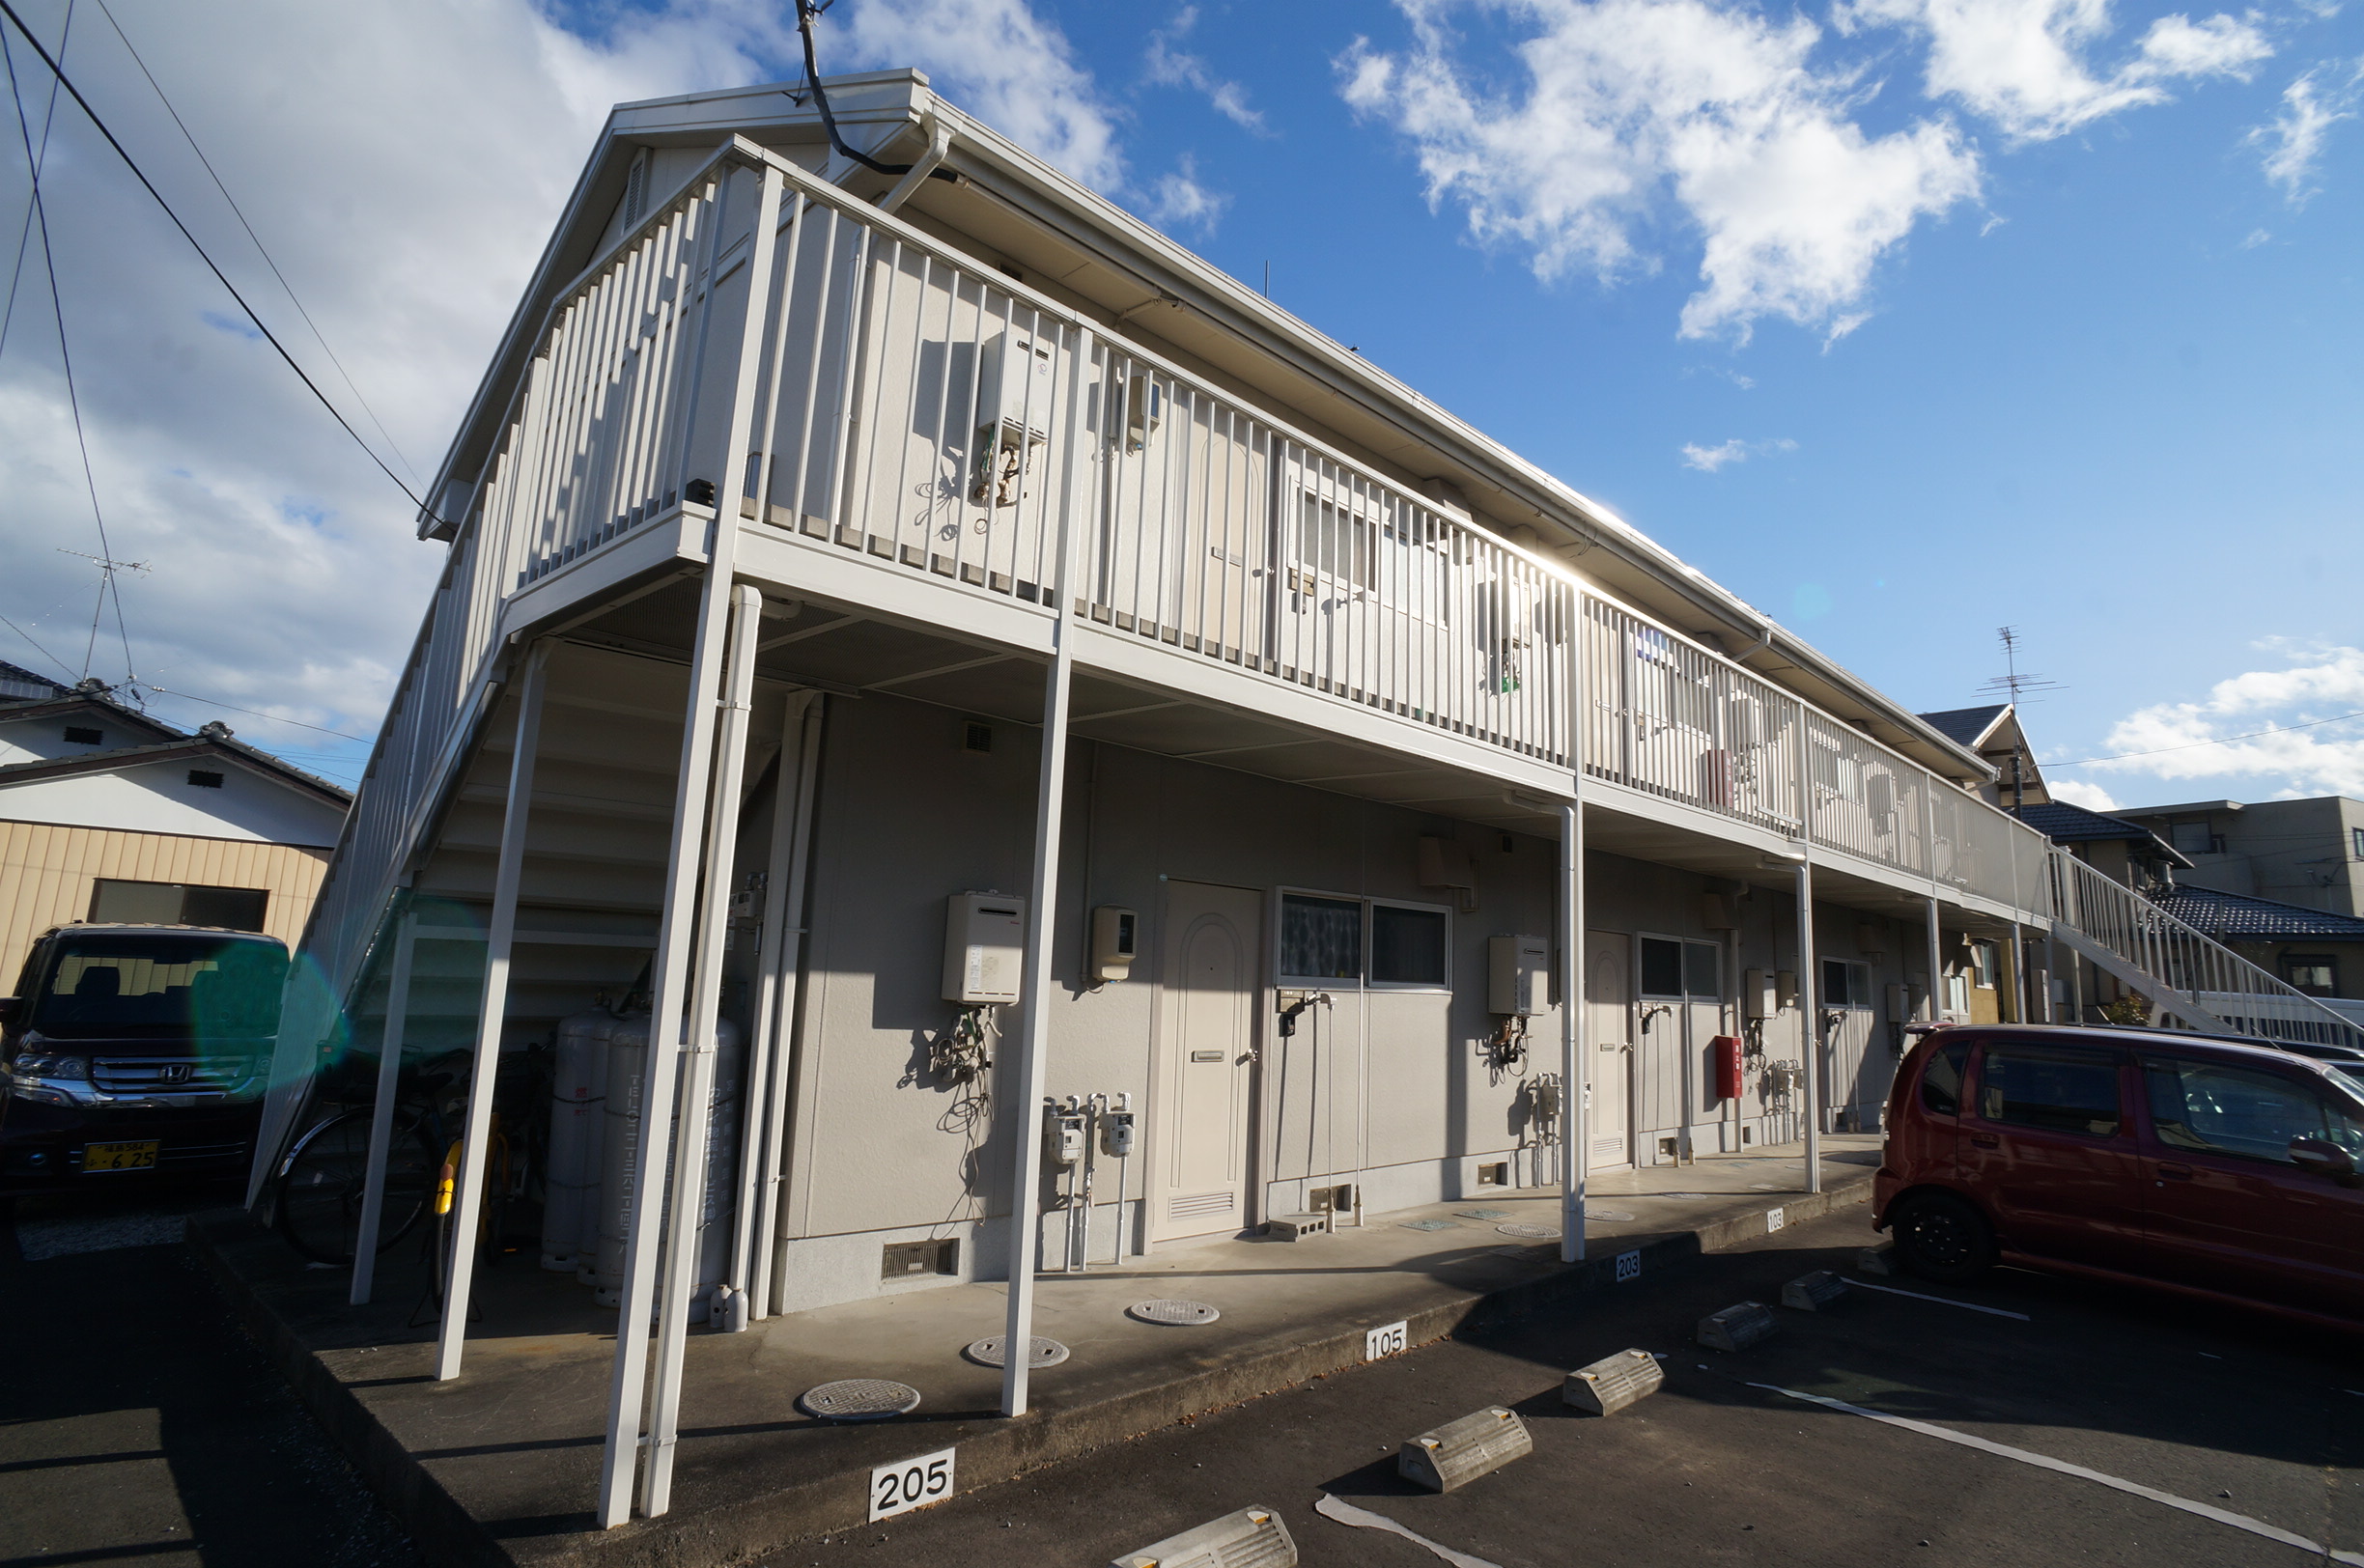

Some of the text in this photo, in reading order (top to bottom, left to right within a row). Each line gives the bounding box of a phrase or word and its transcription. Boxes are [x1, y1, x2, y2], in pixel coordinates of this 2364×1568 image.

[1769, 1212, 1782, 1230] 103
[1618, 1255, 1639, 1277] 203
[1371, 1329, 1402, 1360] 105
[877, 1458, 947, 1511] 205
